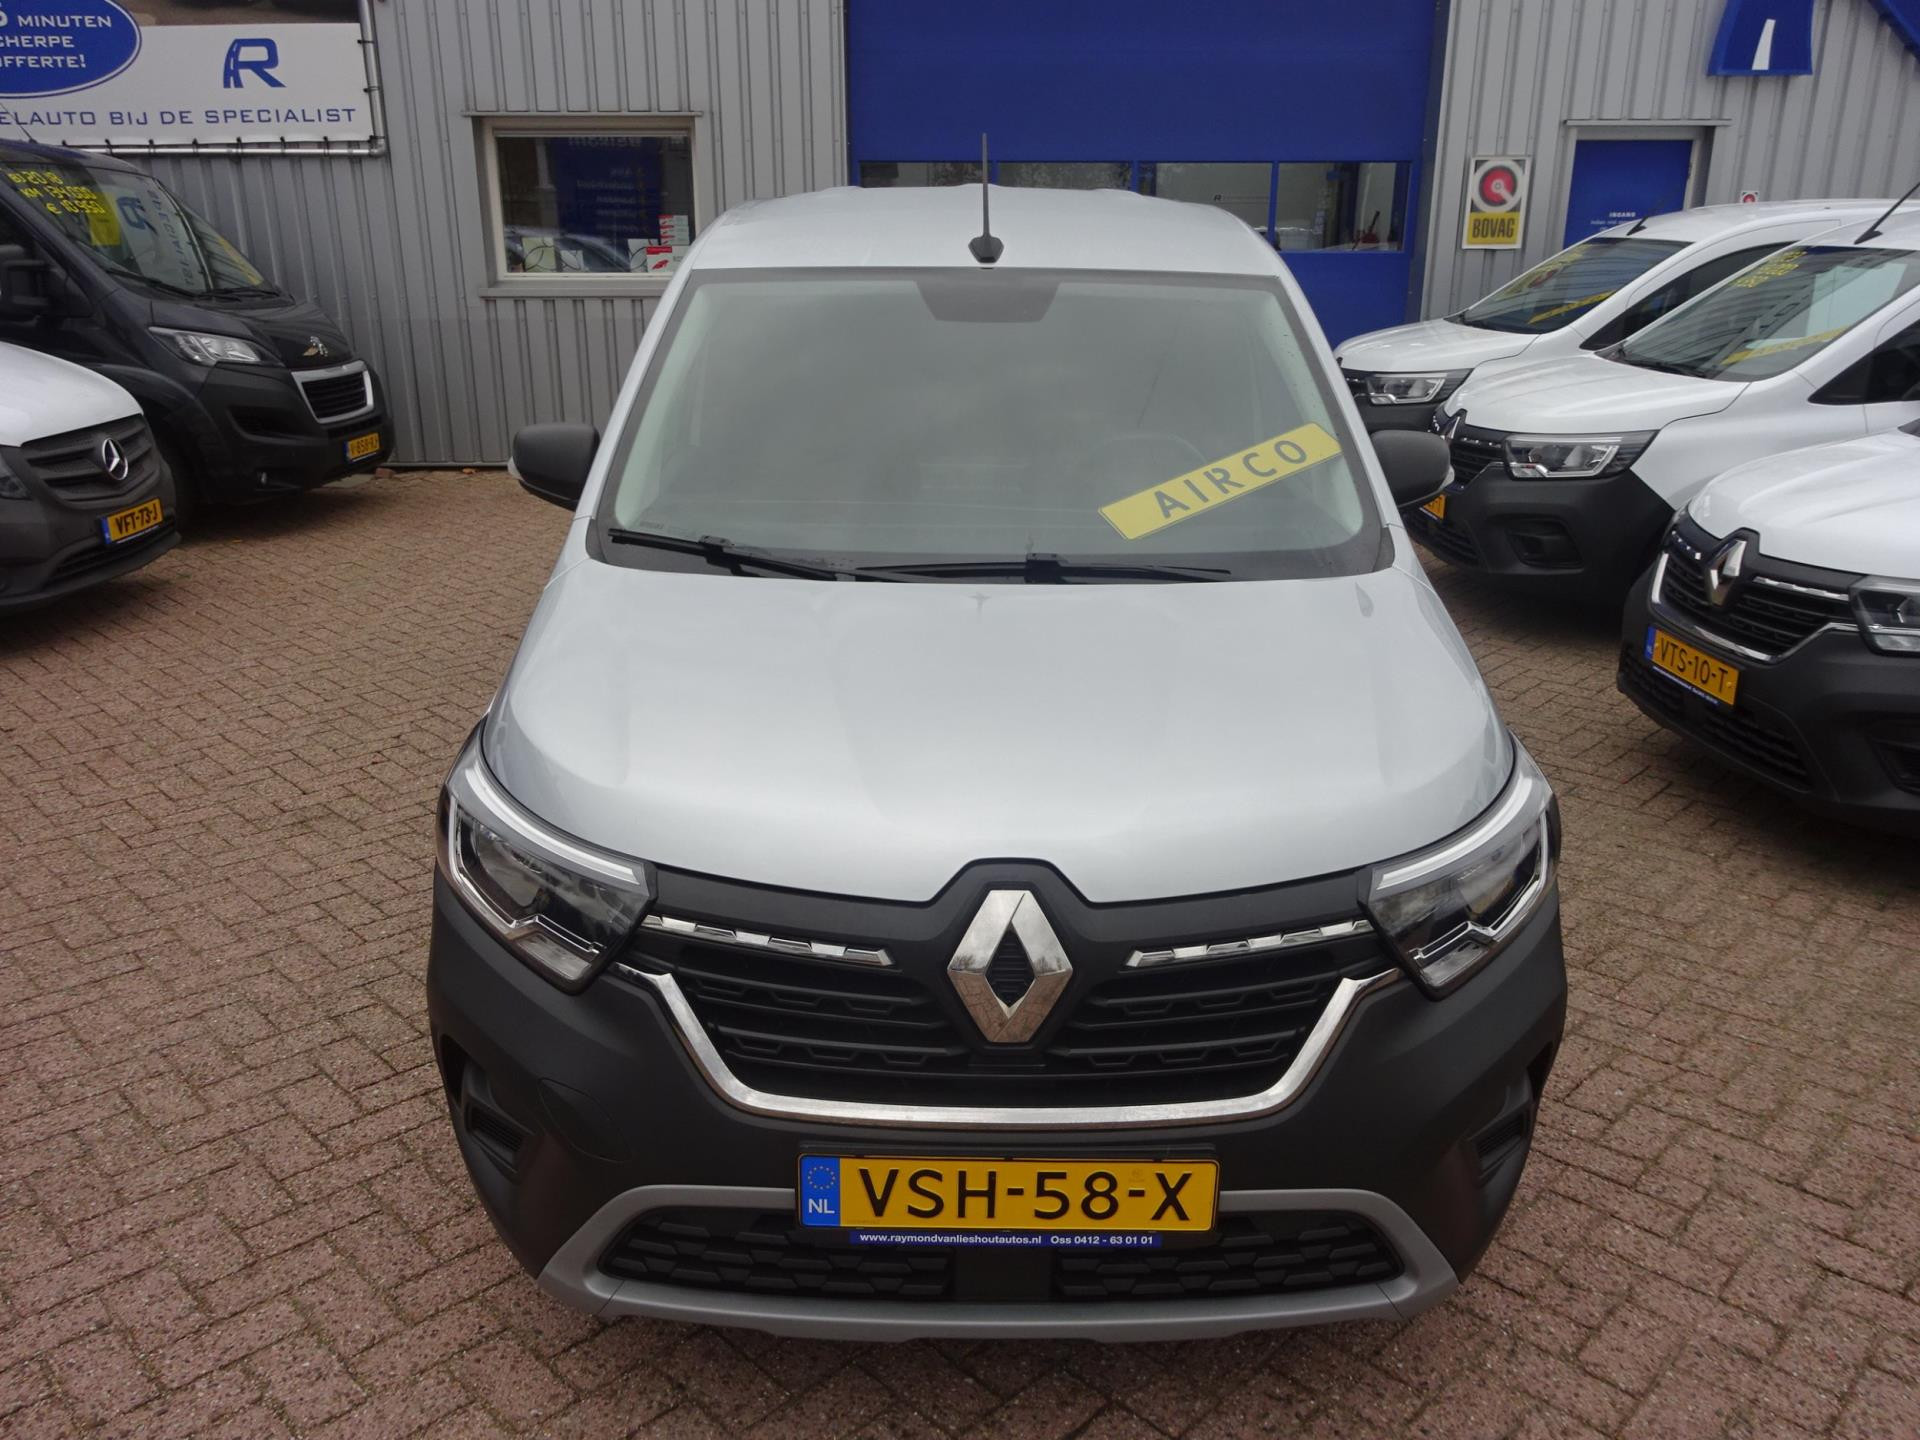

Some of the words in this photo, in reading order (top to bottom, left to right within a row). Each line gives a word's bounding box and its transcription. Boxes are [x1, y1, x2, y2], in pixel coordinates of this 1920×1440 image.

[17, 15, 112, 28] MINUTEN
[0, 54, 87, 68] FFERTE!
[110, 111, 148, 125] BIJ
[160, 110, 193, 123] DE
[204, 108, 356, 124] SPECIALIST
[1471, 217, 1516, 239] BOVAG
[1153, 440, 1308, 519] AIRCO
[1660, 638, 1728, 693] VTS-10-T
[808, 1198, 835, 1215] NL
[859, 1167, 1192, 1221] VSH-58-X
[860, 1233, 1042, 1245] www.raymondvanlieshoutautos.nl
[1050, 1236, 1071, 1245] Oss
[1074, 1236, 1099, 1245] 0412
[1110, 1236, 1123, 1245] 63
[1125, 1236, 1138, 1245] 01
[1140, 1236, 1153, 1245] 01
